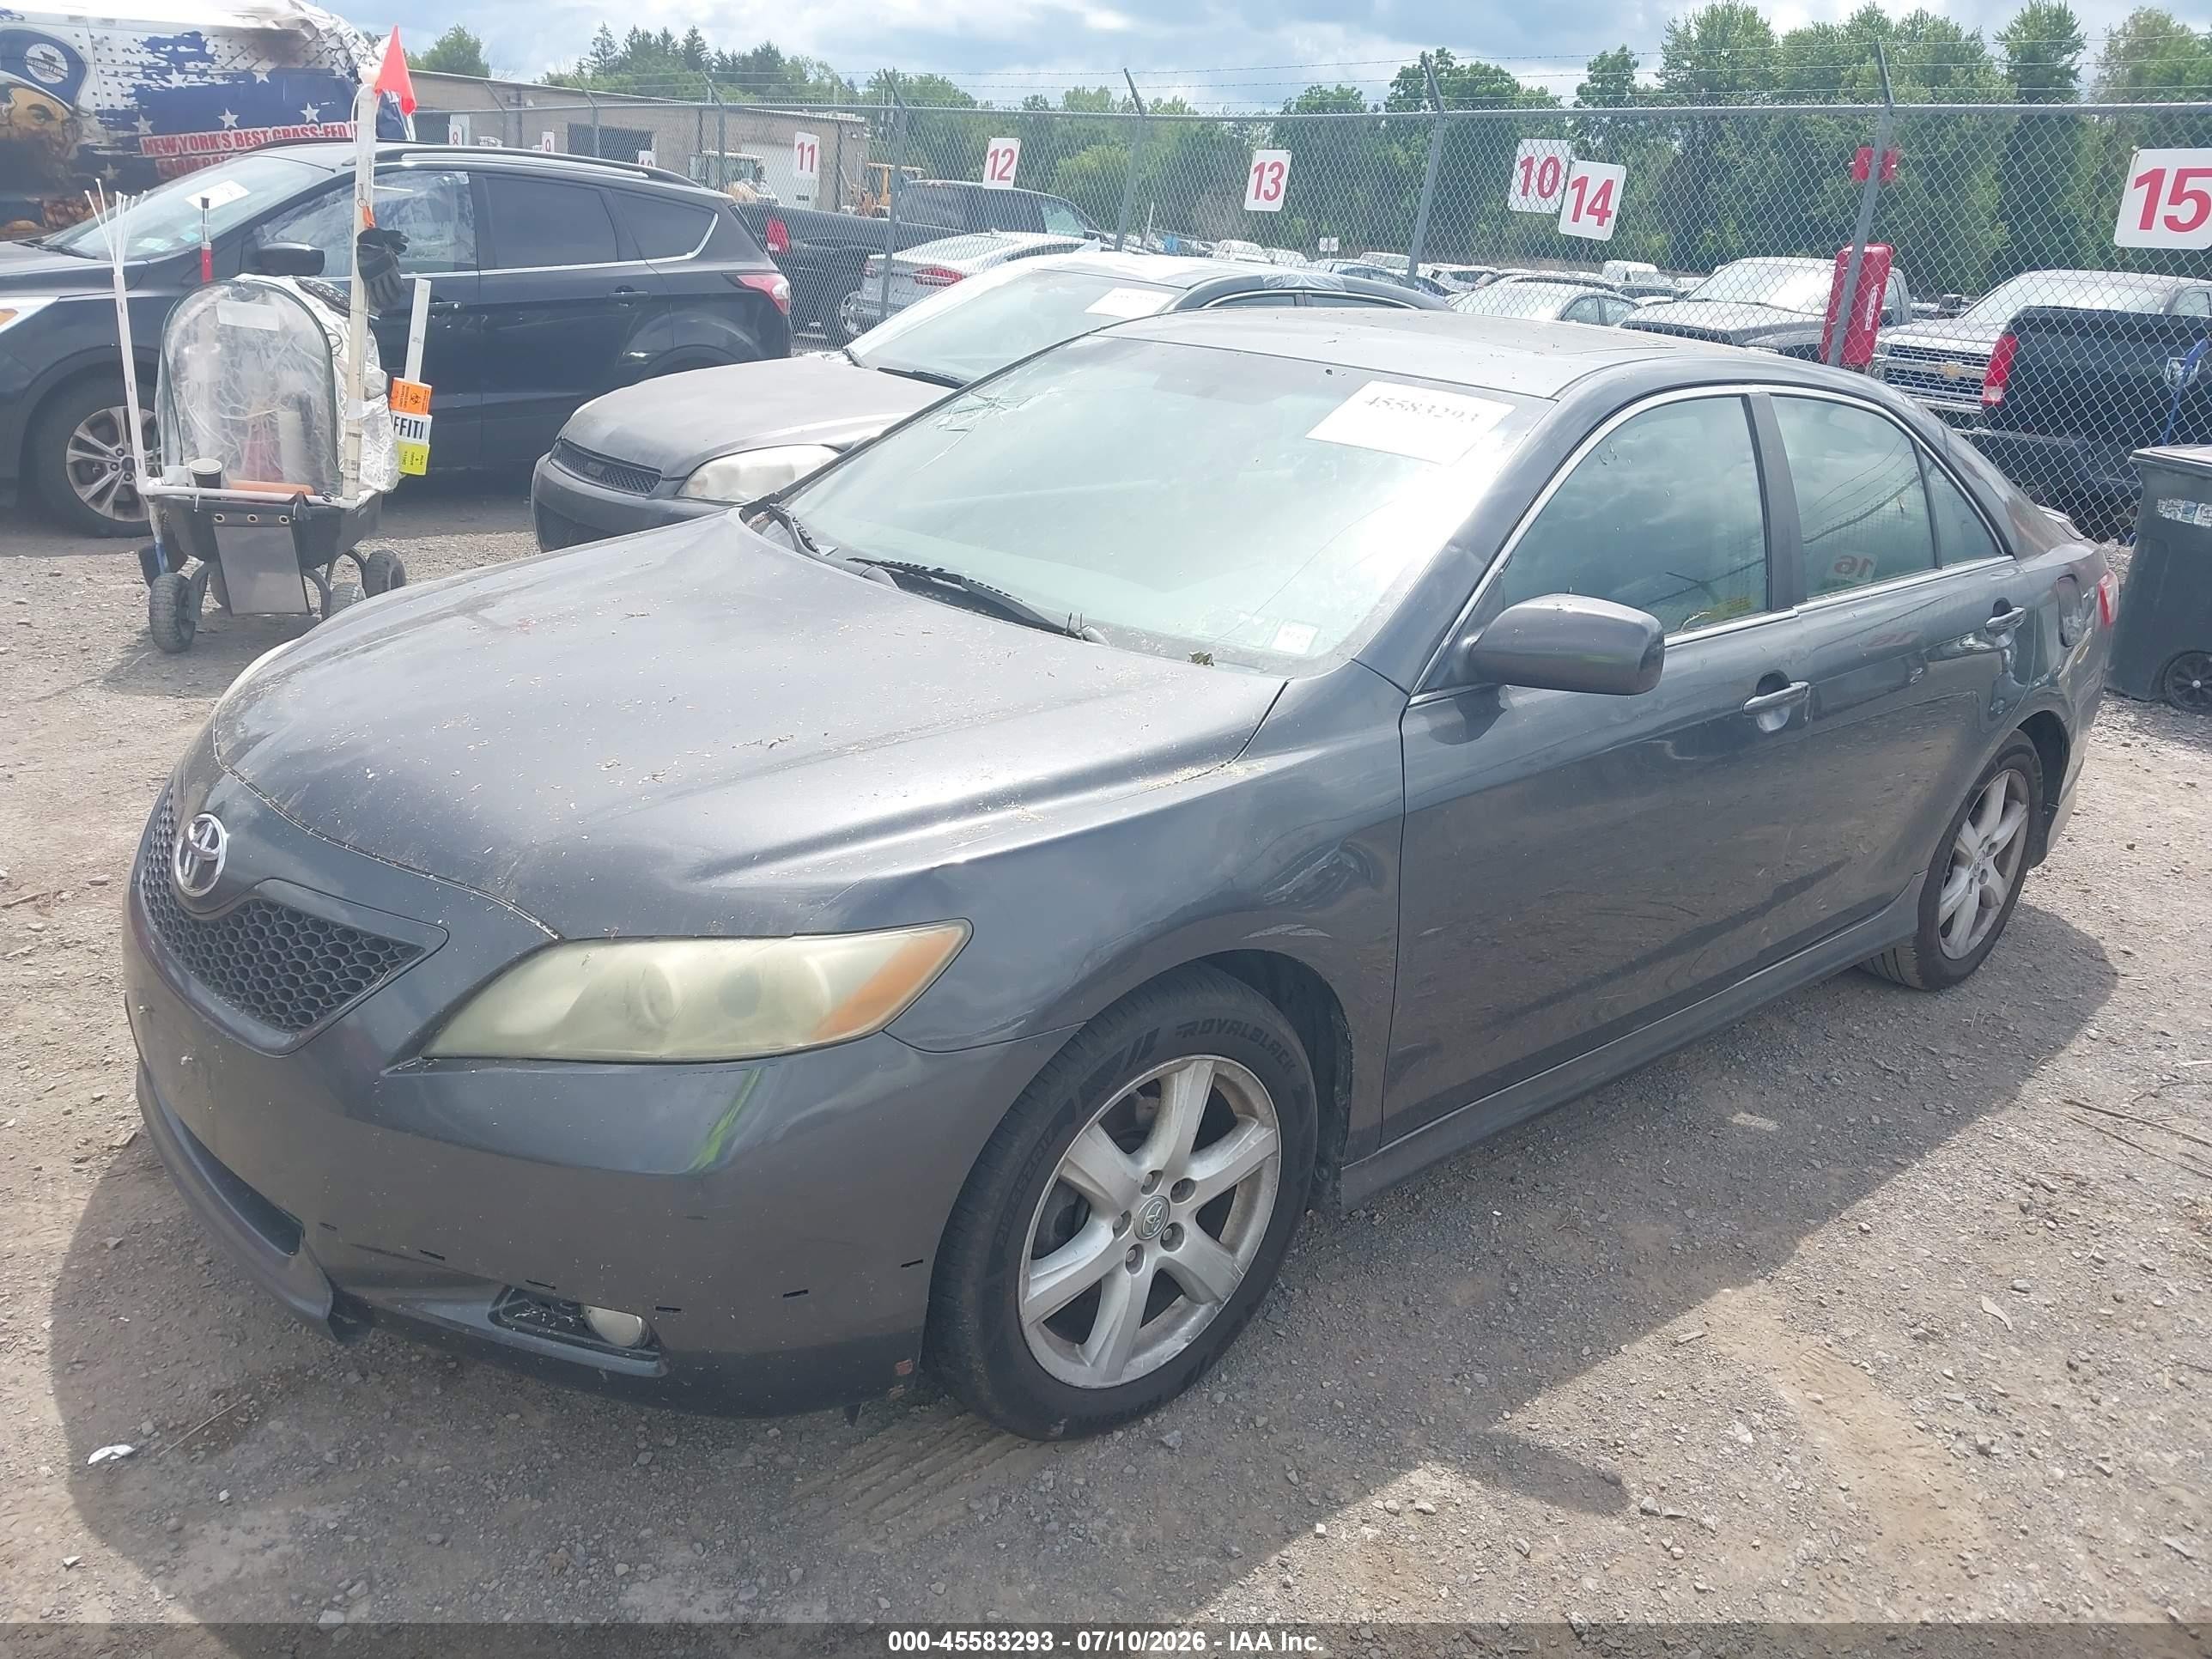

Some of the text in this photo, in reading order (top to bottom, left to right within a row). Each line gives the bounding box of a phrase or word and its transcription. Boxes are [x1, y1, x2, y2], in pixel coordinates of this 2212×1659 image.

[142, 136, 178, 155] NEW
[178, 131, 231, 153] YORK'S
[234, 128, 269, 149] BEST
[796, 142, 817, 173] 11
[988, 149, 1015, 181] 12
[1253, 161, 1285, 202] 13
[1518, 155, 1561, 198] 10
[1570, 175, 1614, 227] 14
[2133, 167, 2212, 234] 15
[392, 415, 425, 440] FFITI
